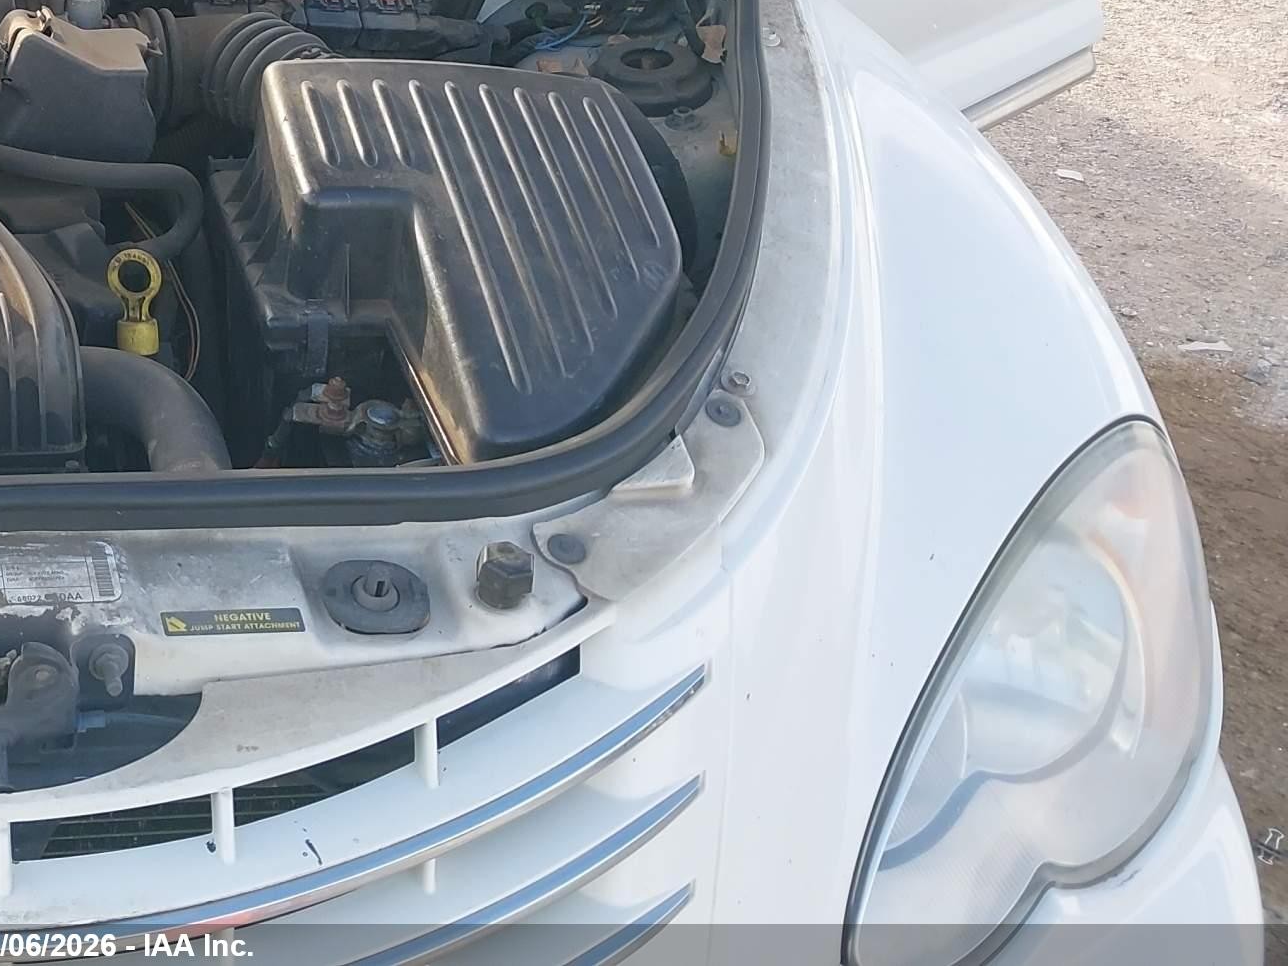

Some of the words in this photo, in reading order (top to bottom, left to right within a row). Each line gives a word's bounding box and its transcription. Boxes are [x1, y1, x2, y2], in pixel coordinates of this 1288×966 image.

[213, 612, 272, 622] NEGATIVE
[191, 624, 214, 632] JUMP
[216, 623, 242, 631] START
[244, 621, 301, 630] ATTACHMENT
